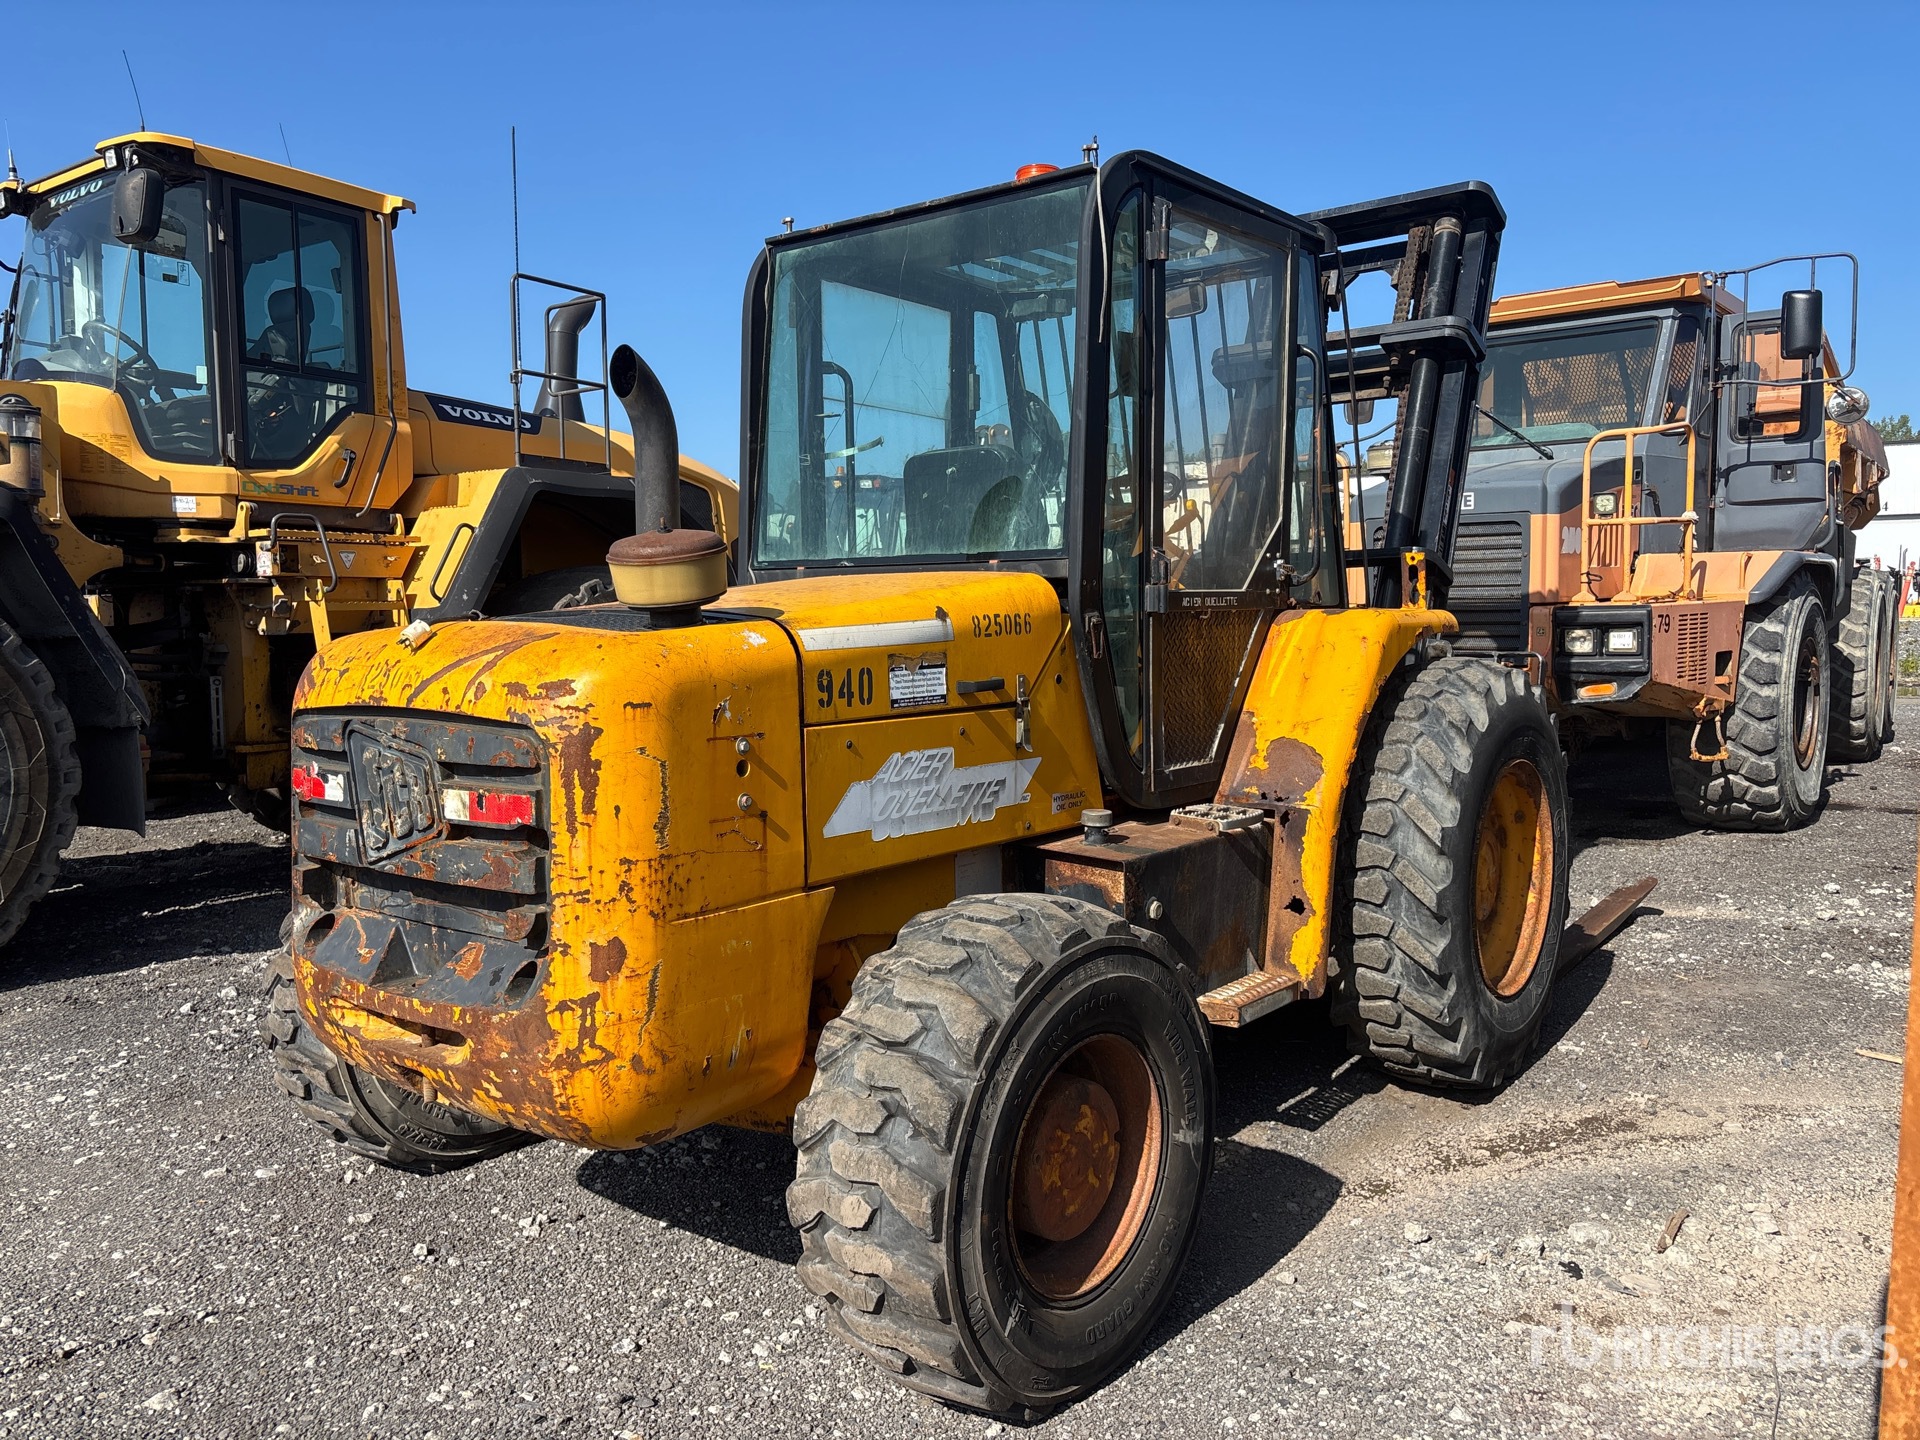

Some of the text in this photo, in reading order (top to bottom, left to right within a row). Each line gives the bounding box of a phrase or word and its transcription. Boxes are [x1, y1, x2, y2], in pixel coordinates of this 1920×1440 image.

[49, 179, 103, 208] VOLVO
[438, 403, 532, 429] VOLVO
[241, 480, 320, 498] OptiShift
[1181, 596, 1238, 607] ACIER OUELLETTE
[971, 612, 1032, 639] 825066
[1657, 613, 1671, 634] 79
[817, 666, 874, 709] 940
[875, 748, 952, 785] ACIER
[872, 776, 1007, 823] OUELLETTE
[1053, 790, 1086, 804] HYDRAULIC
[1056, 799, 1084, 813] OIL ONLY
[1085, 1297, 1136, 1346] GUARD
